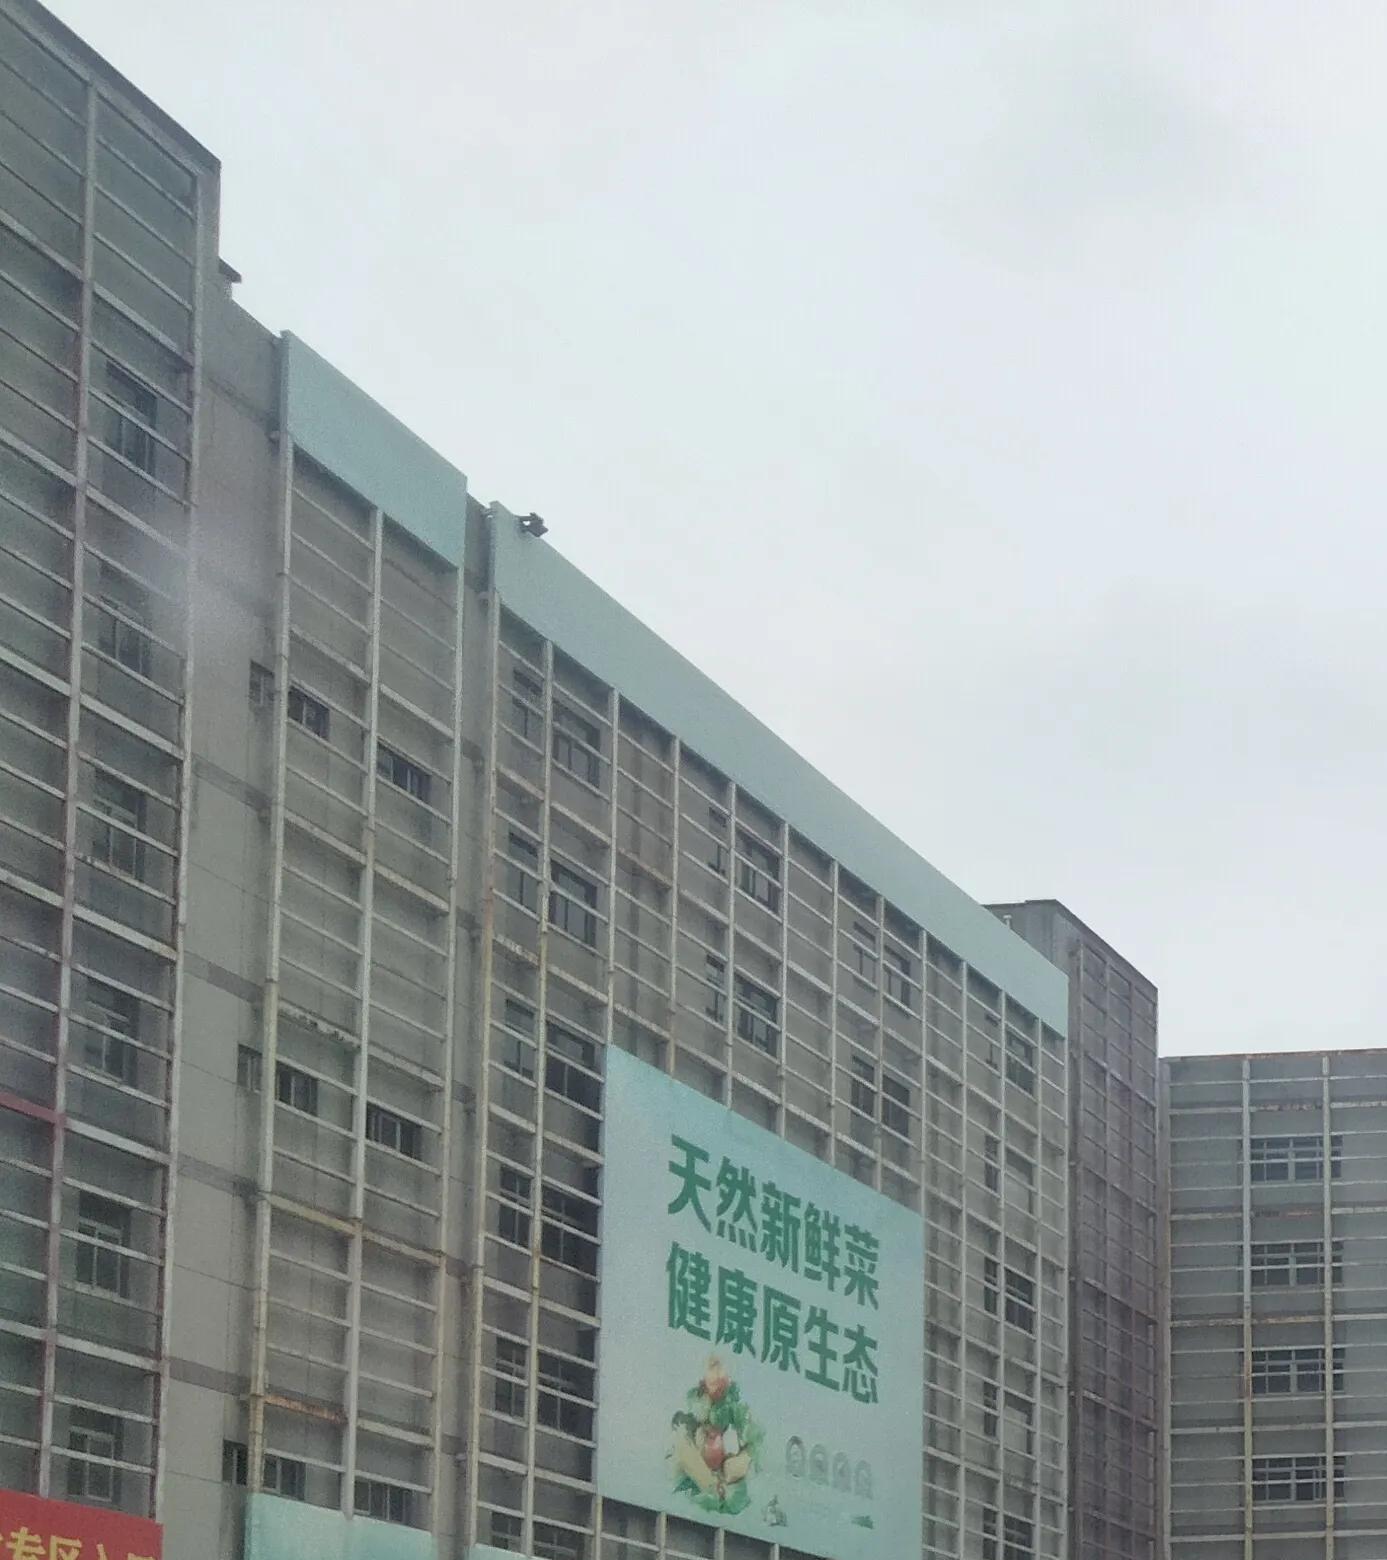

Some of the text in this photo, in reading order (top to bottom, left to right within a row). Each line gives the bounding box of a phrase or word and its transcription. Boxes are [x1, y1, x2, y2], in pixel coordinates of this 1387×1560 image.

[667, 1134, 880, 1310] 天然新鲜菜
[667, 1242, 880, 1405] 健康原生态
